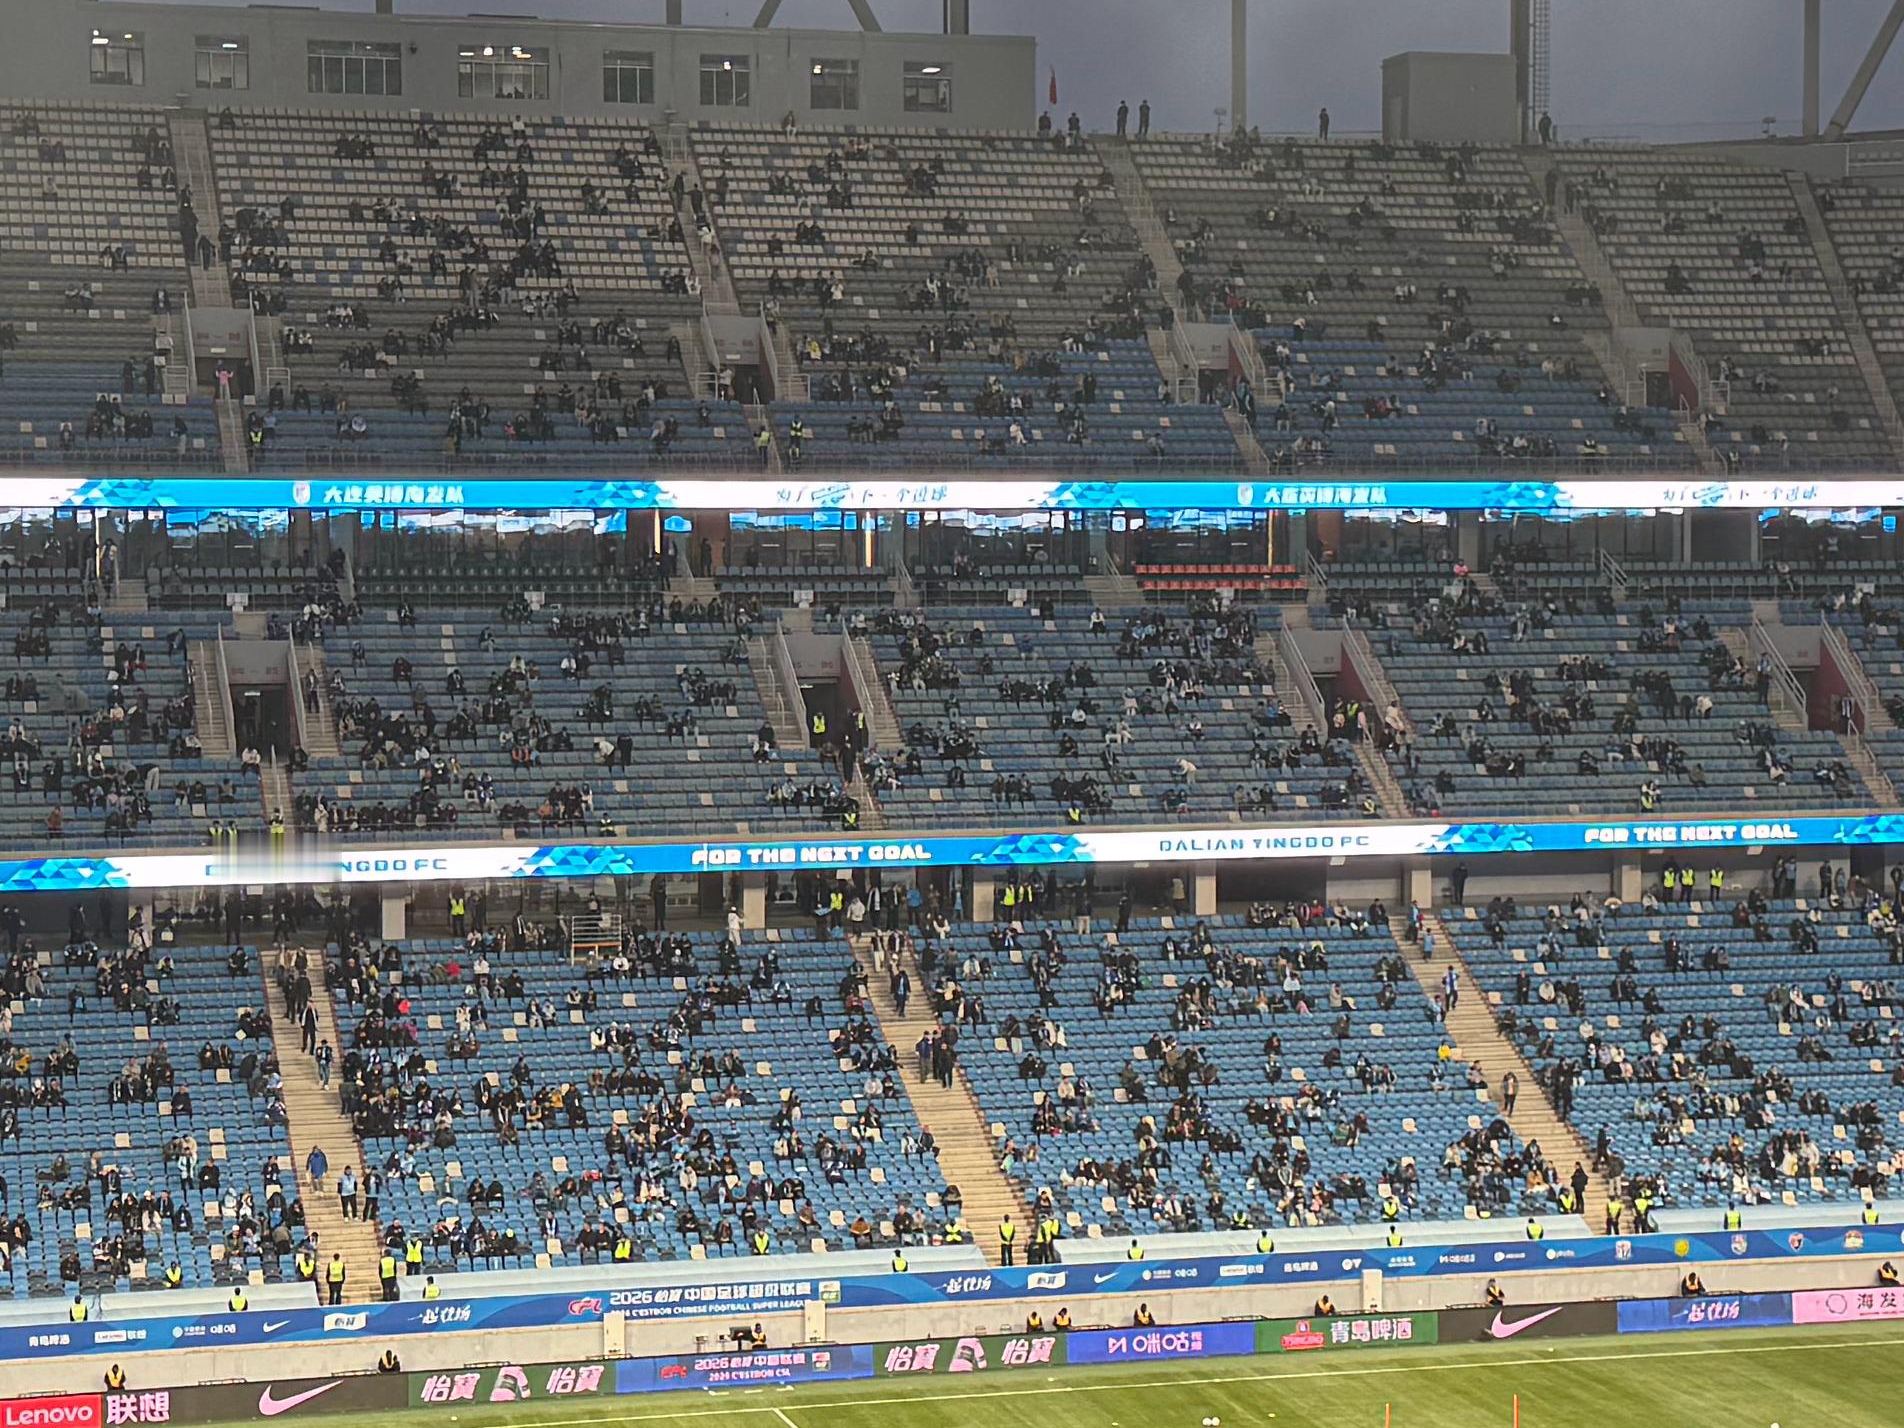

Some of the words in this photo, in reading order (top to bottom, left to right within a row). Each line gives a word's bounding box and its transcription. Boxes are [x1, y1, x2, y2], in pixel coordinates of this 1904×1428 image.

[1158, 837, 1244, 852] DALIAN
[1340, 834, 1371, 848] FC
[1584, 827, 1628, 844] FOR
[1633, 825, 1678, 842] THE
[1681, 824, 1736, 841] NEXT
[1740, 823, 1799, 840] GOAL
[413, 857, 448, 871] FC
[691, 847, 741, 865] FOR
[746, 846, 797, 864] THE
[800, 845, 862, 863] NEXT
[867, 843, 932, 861] GOAL
[610, 1290, 652, 1305] 2026
[1330, 1317, 1413, 1344] 青岛啤酒
[694, 1358, 729, 1371] 2026
[5, 1403, 94, 1427] Lenovo
[106, 1393, 170, 1426] 联想
